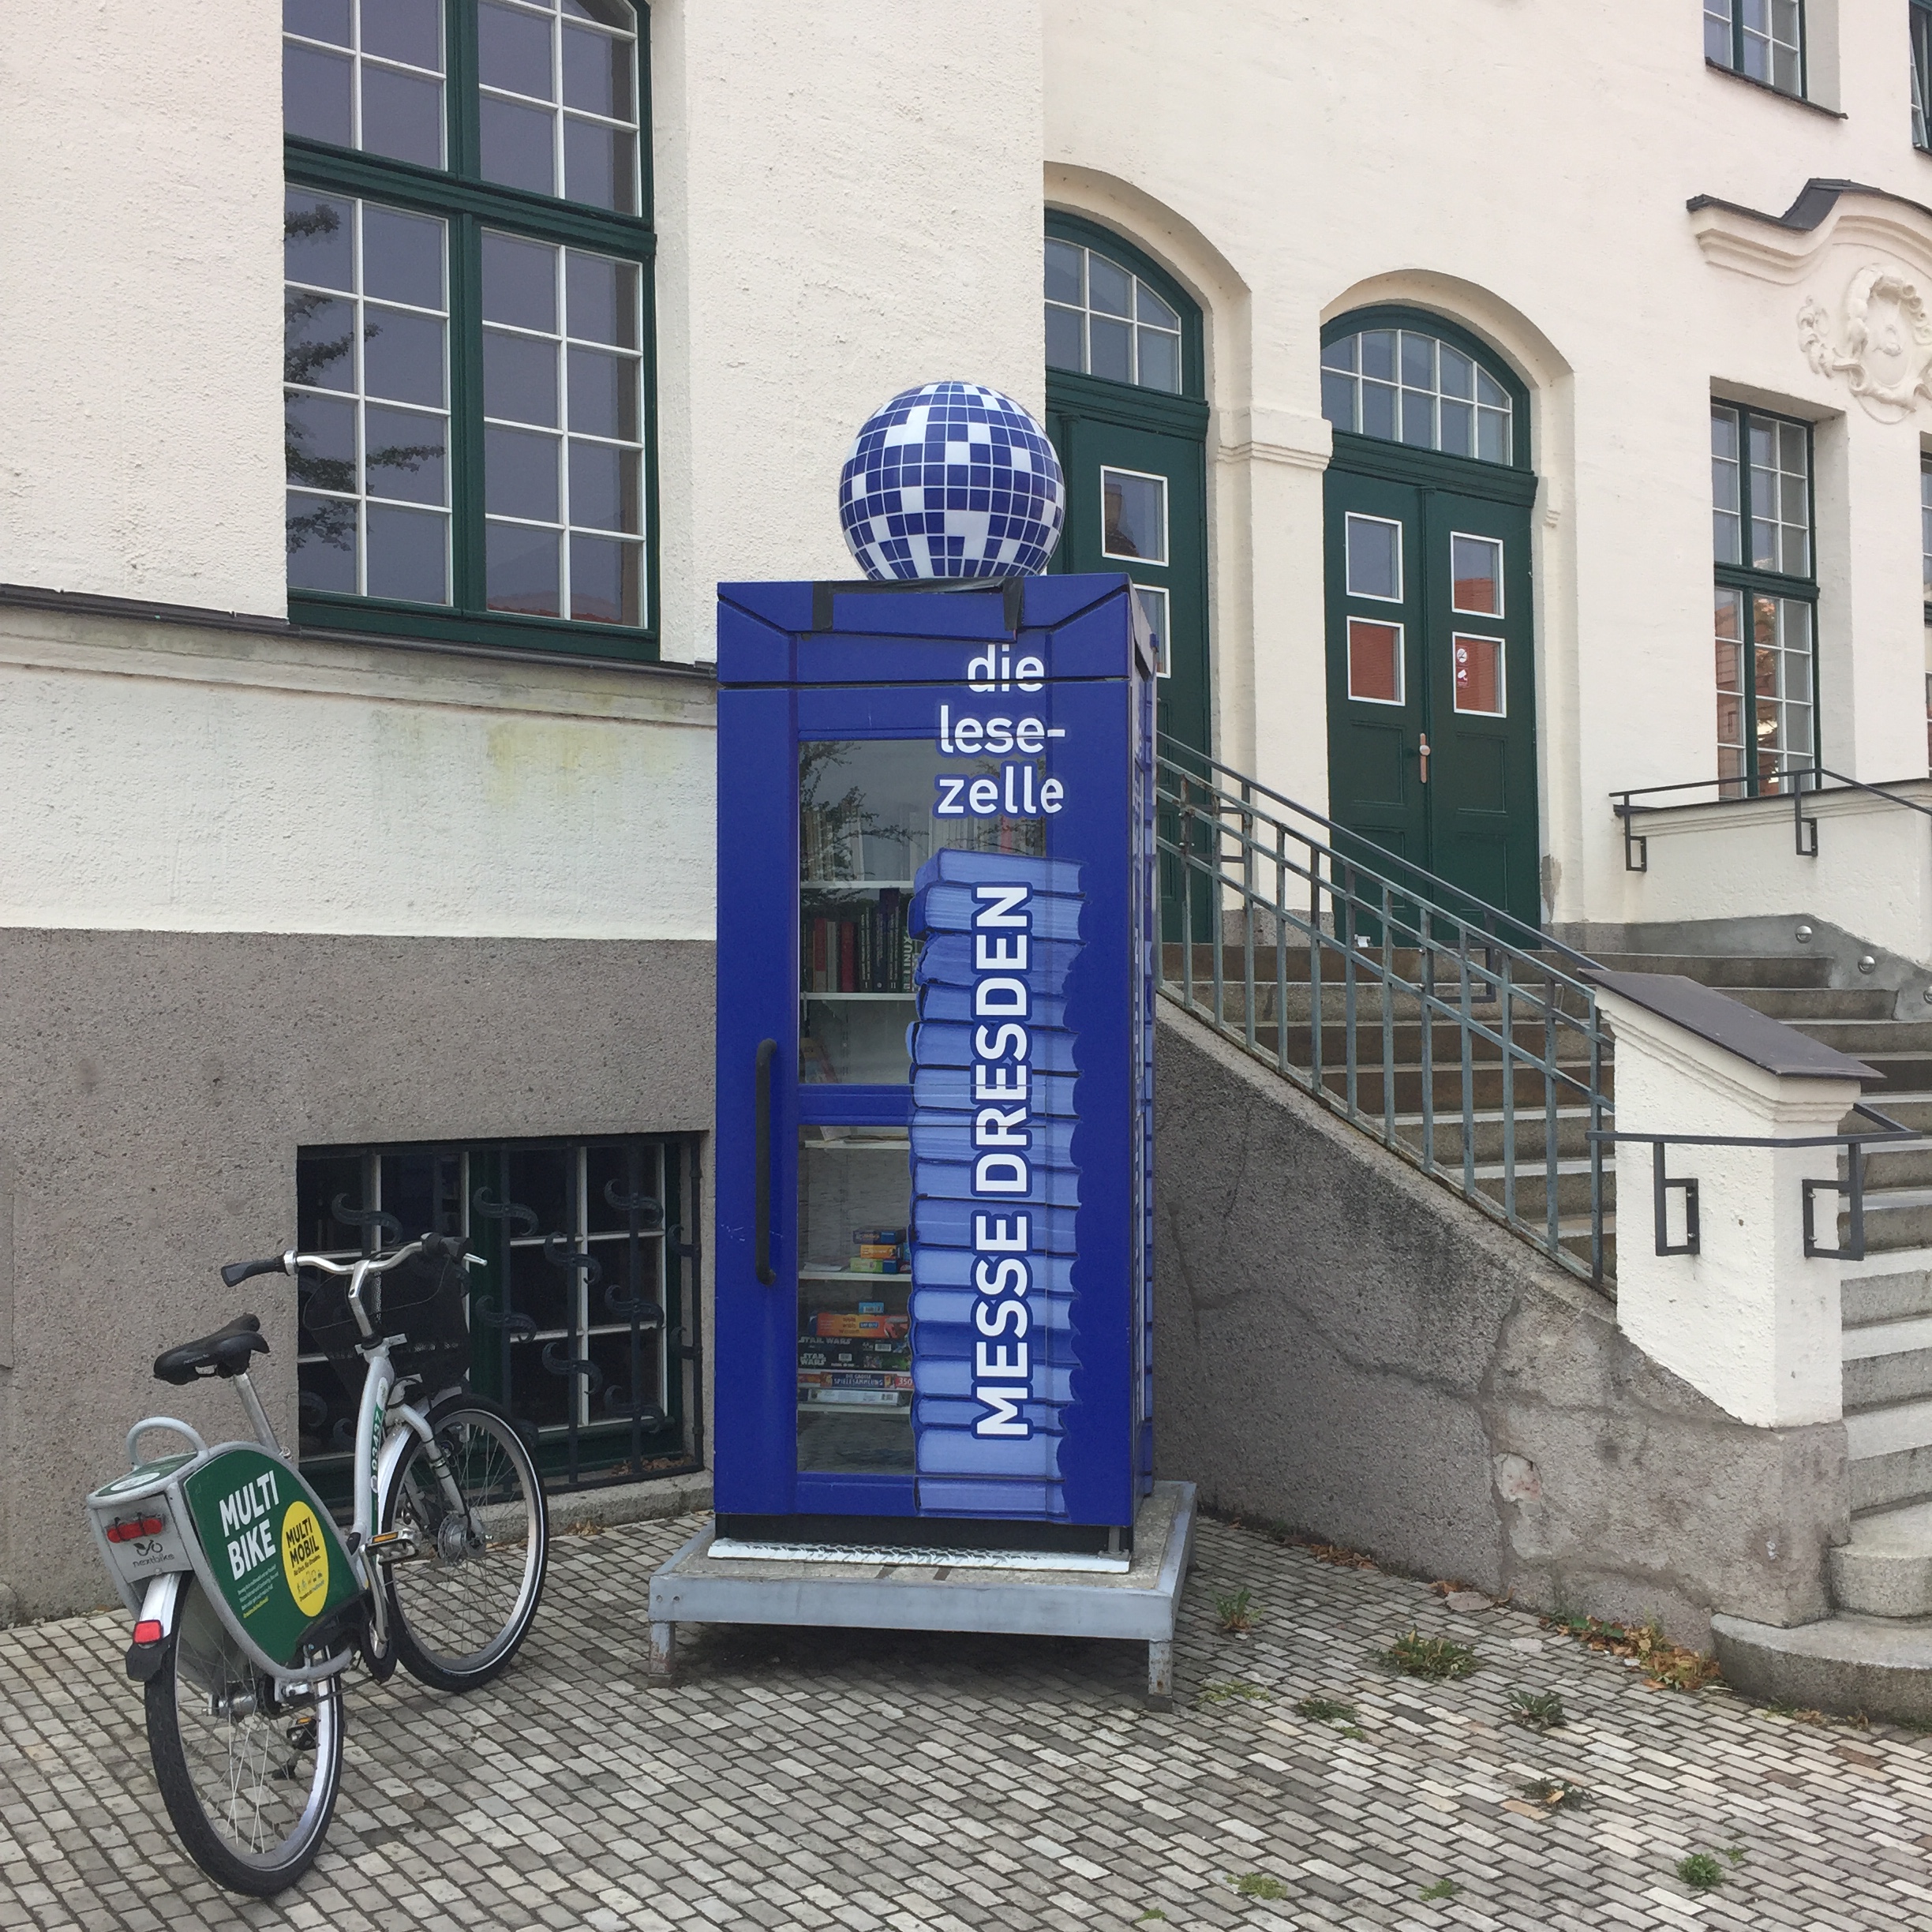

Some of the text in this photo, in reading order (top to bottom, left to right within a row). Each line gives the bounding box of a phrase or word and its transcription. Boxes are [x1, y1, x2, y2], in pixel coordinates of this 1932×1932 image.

[968, 644, 1044, 692] die
[941, 705, 1065, 753] lese-
[938, 766, 1064, 814] zelle
[975, 887, 1029, 1436] MESSE DRESDEN
[219, 1470, 279, 1537] MULTI
[227, 1518, 276, 1581] BIKE
[286, 1516, 313, 1548] MULTI
[289, 1535, 320, 1568] MOBIL
[132, 1553, 175, 1568] nextbike
